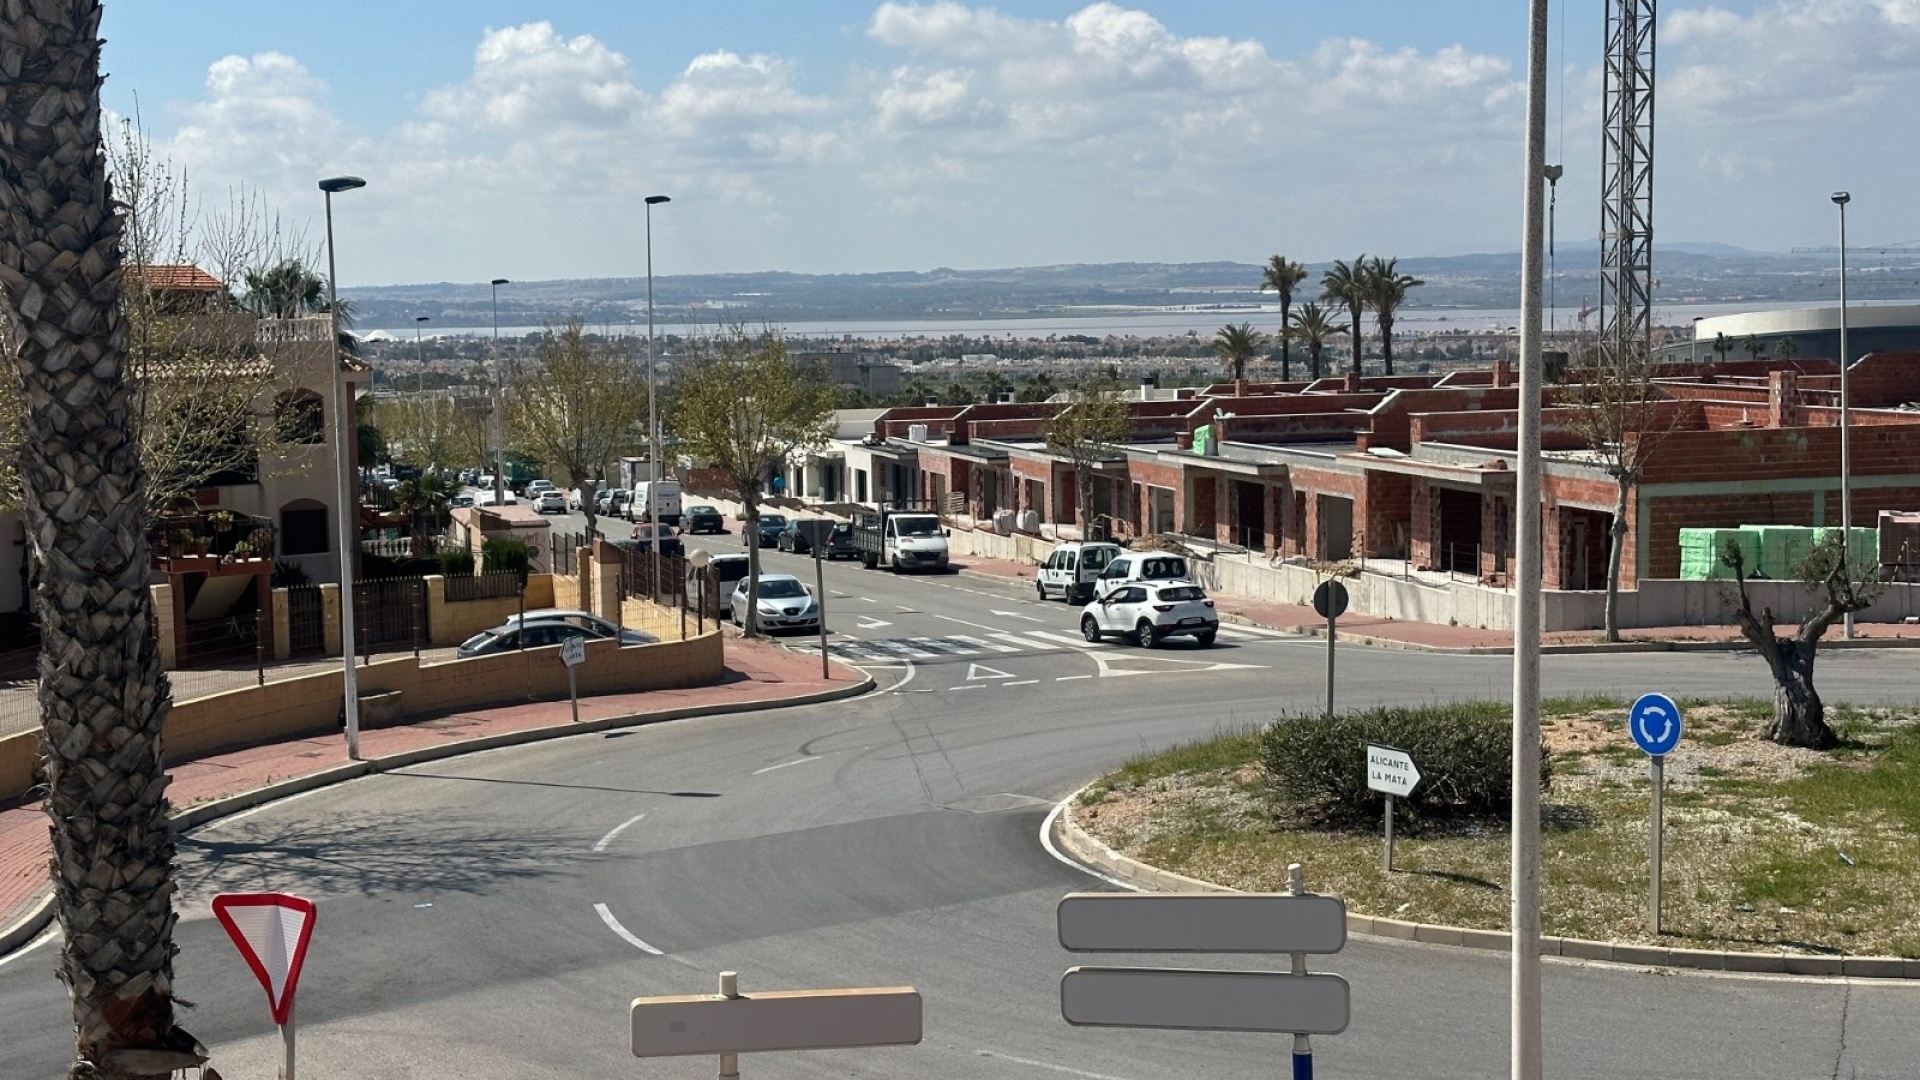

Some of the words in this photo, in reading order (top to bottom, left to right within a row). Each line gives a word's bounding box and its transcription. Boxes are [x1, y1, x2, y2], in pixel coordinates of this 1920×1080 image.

[1370, 755, 1409, 771] ALICANTE
[1372, 770, 1381, 780] LA
[1385, 773, 1407, 786] MATA
